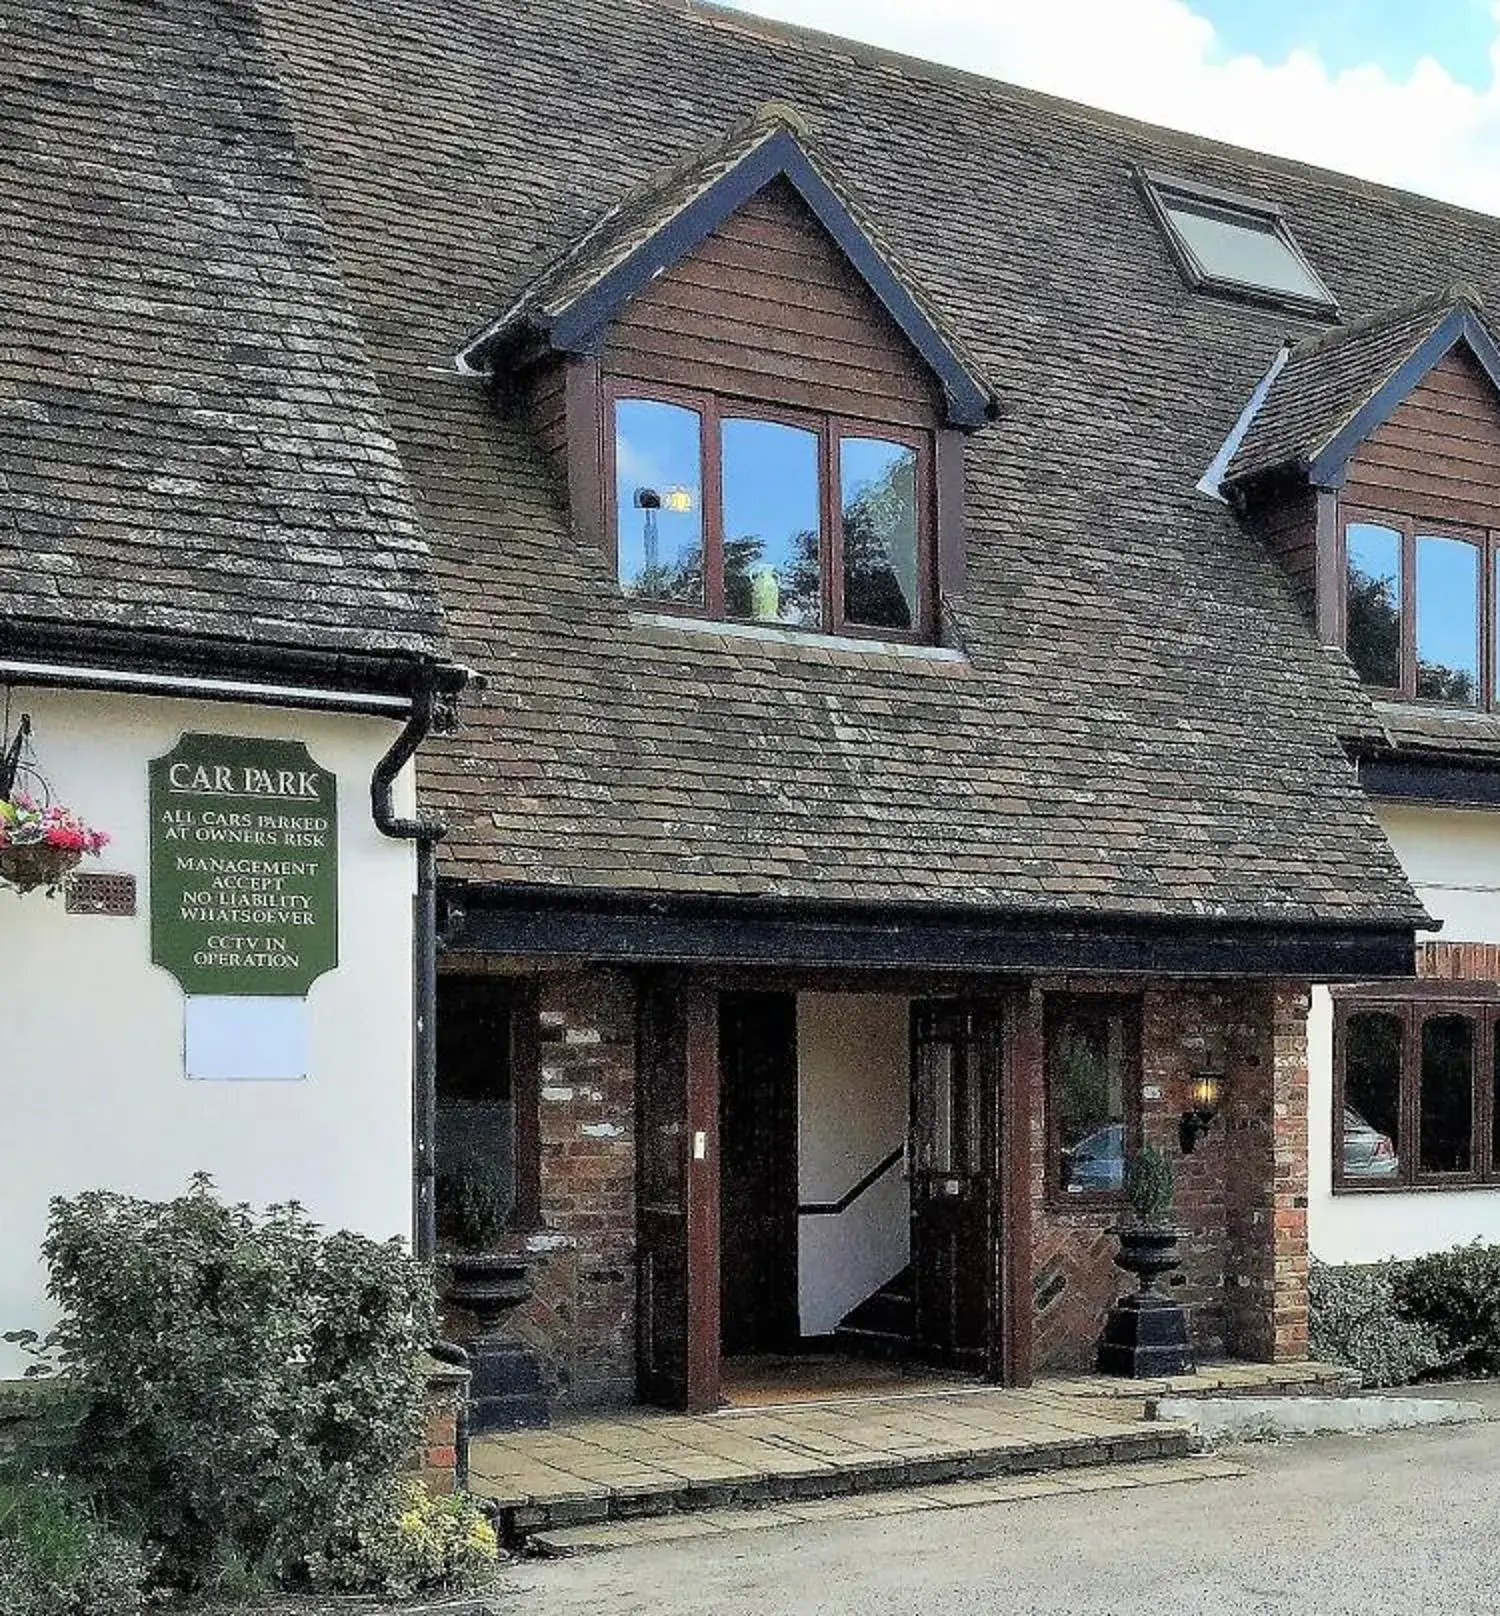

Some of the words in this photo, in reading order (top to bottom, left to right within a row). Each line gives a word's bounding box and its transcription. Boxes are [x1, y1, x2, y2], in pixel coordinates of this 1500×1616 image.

[169, 763, 234, 791] CAR
[243, 767, 319, 796] PARK
[161, 809, 193, 823] ALL
[202, 811, 250, 827] CARS
[258, 815, 328, 830] PARKED
[165, 828, 191, 840] AT
[195, 828, 276, 844] OWNERS
[284, 832, 325, 847] RISK
[176, 857, 318, 876] MANAGEMENT
[212, 875, 285, 891] ACCEPT
[183, 891, 211, 905] NO
[220, 891, 314, 909] LIABILITY
[180, 907, 315, 925] WHATSOEVER
[207, 935, 259, 949] CCTV
[267, 937, 286, 950] IN
[193, 952, 299, 967] OPERATION
